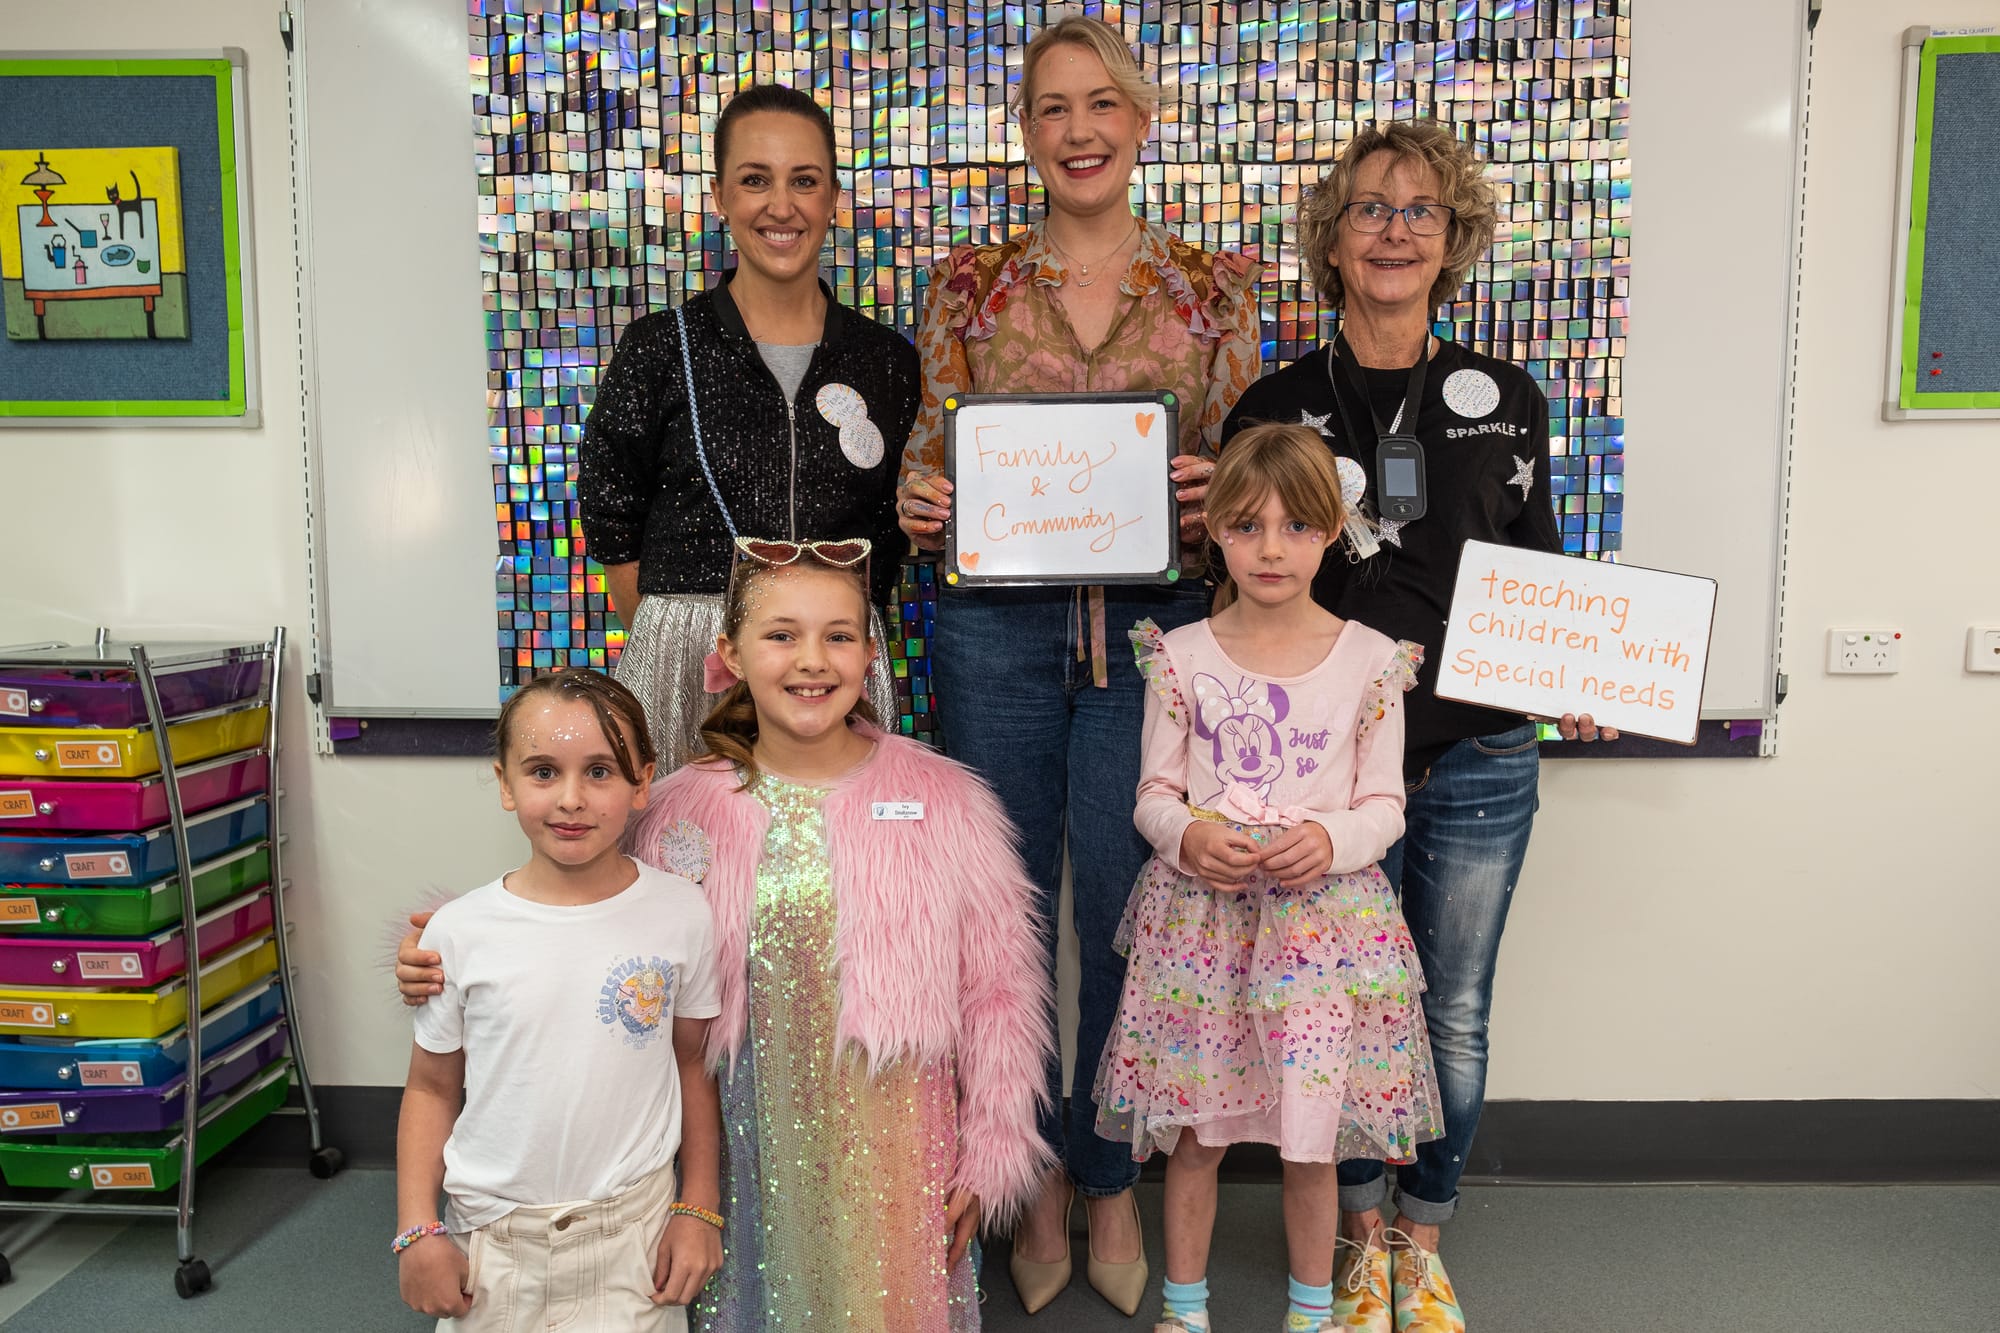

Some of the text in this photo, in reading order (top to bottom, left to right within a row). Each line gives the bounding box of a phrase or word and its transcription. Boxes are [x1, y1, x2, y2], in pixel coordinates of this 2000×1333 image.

[1446, 422, 1516, 439] SPARKLE
[976, 424, 1117, 493] Family
[1030, 476, 1050, 496] &
[983, 503, 1143, 552] Community
[1480, 569, 1630, 634] teaching
[1621, 639, 1690, 672] with
[1581, 675, 1675, 711] needs
[1289, 727, 1332, 750] Just
[65, 749, 91, 760] CRAFT
[3, 799, 28, 810] CRAFT
[70, 861, 96, 872] CRAFT
[7, 905, 32, 915] CRAFT
[86, 960, 110, 970] CRAFT
[1, 1008, 25, 1019] CRAFT
[83, 1069, 107, 1079] CRAFT
[30, 1110, 56, 1121] CRAFT
[123, 1172, 148, 1182] CRAFT
